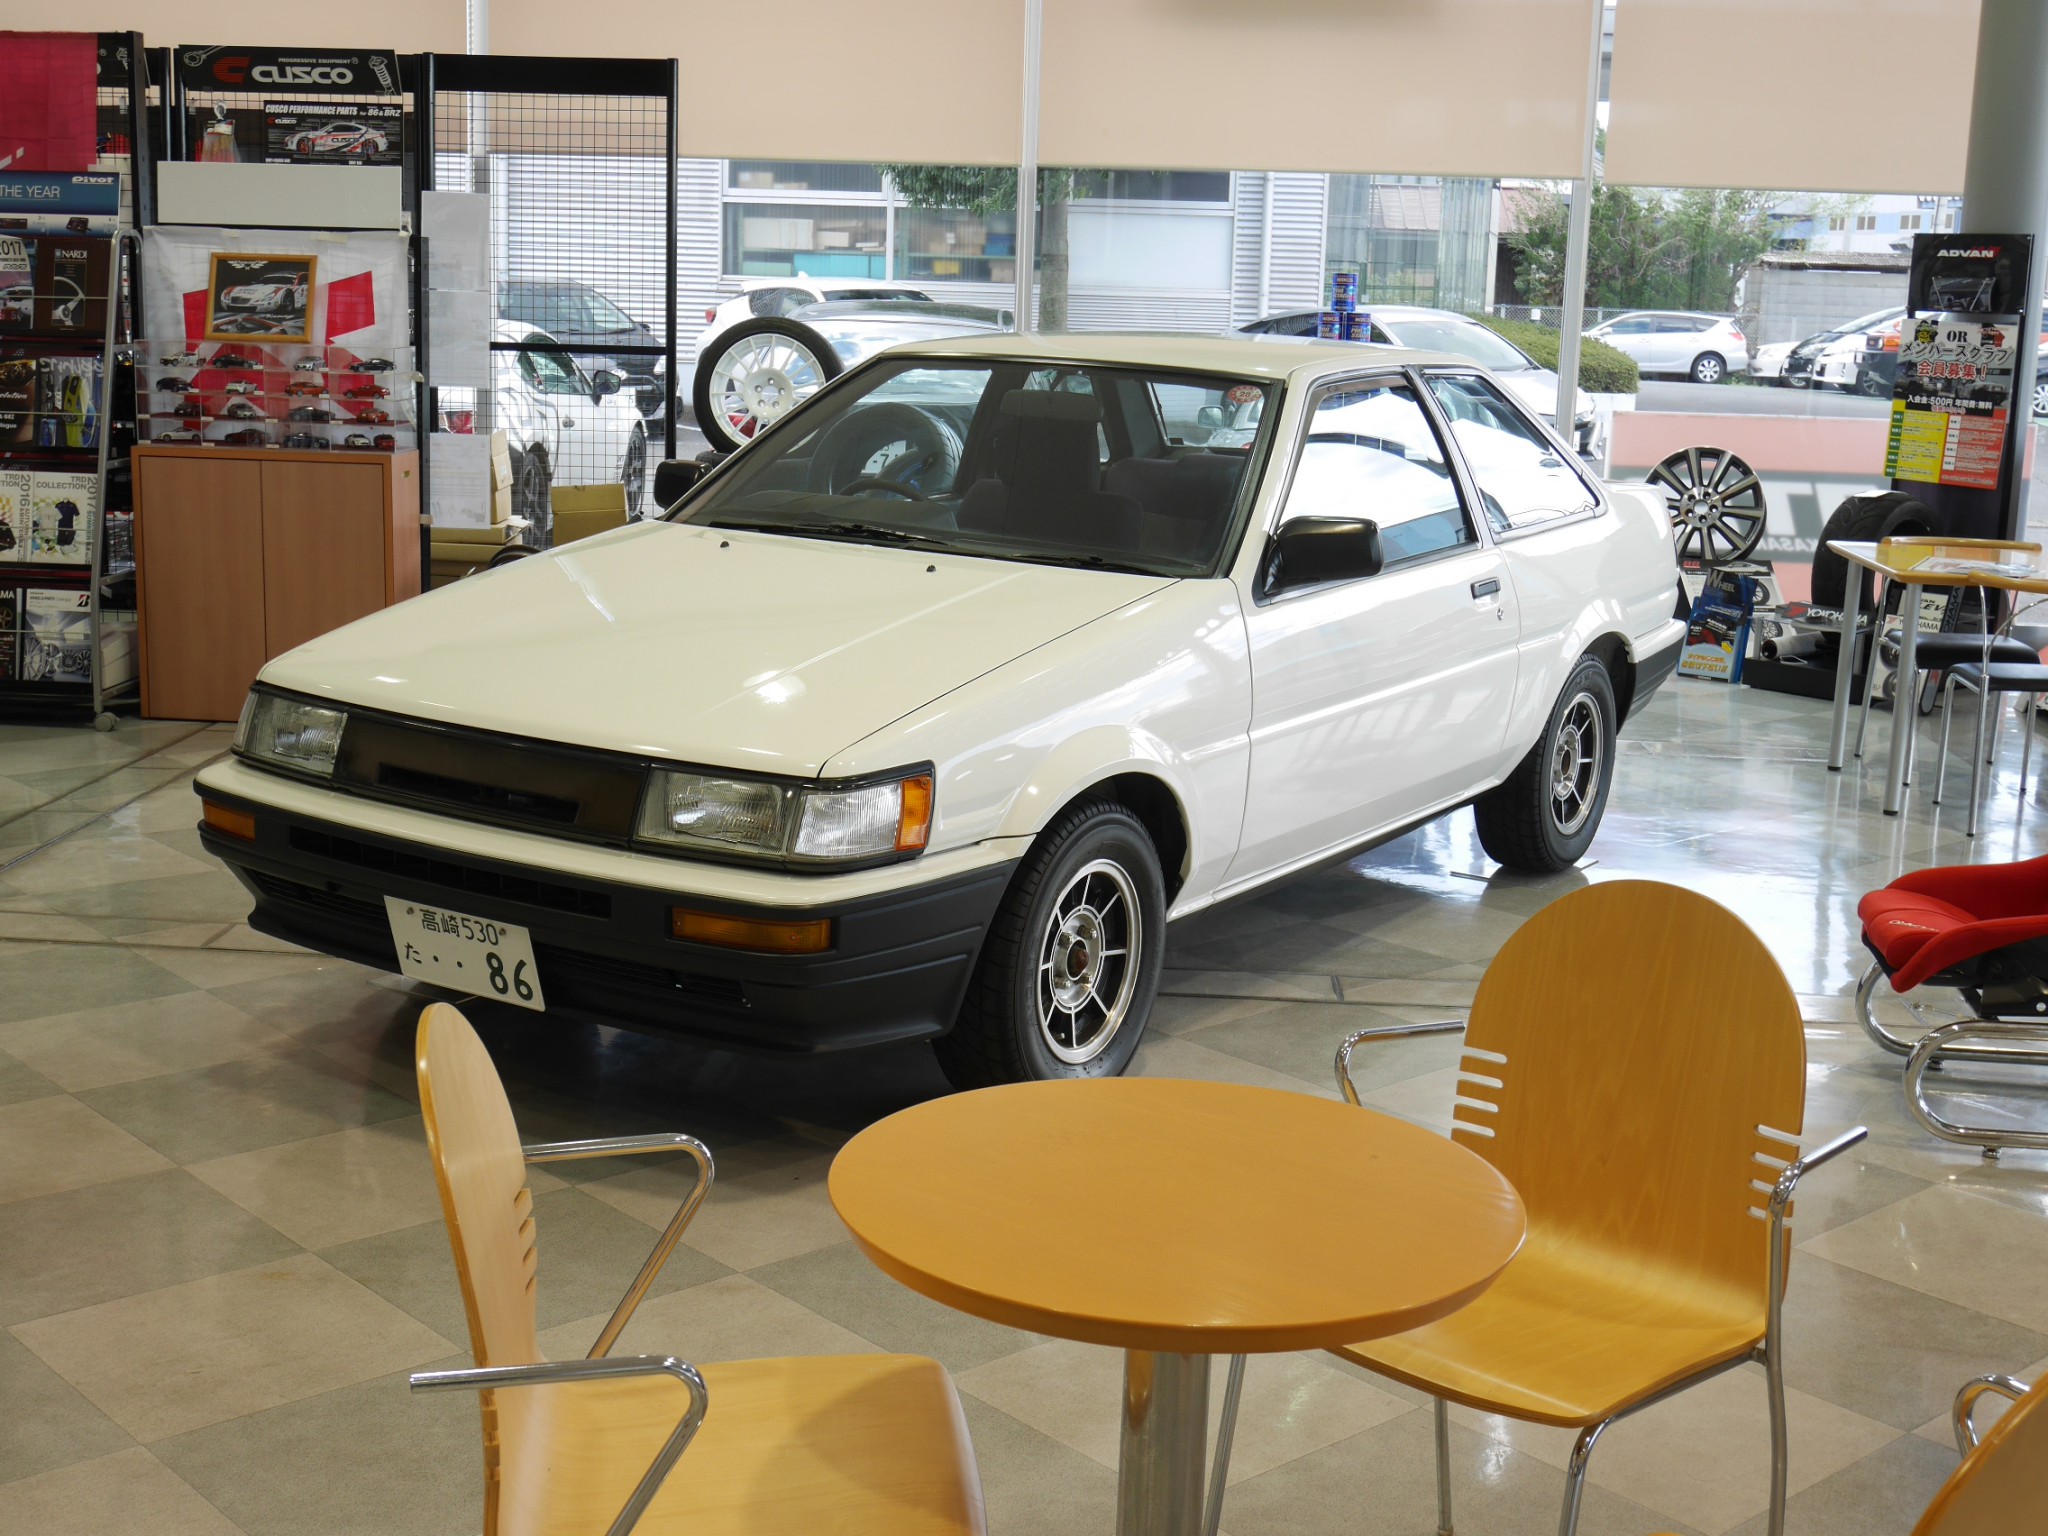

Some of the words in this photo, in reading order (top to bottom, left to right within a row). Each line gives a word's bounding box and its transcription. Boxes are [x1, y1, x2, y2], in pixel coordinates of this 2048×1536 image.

[251, 65, 354, 85] CUSCO
[265, 104, 288, 114] CUSCO
[289, 105, 335, 115] PERFORMANCE
[336, 106, 358, 116] PARTS
[367, 108, 379, 117] 86
[384, 109, 401, 117] BRZ
[26, 186, 61, 198] YEAR
[0, 240, 22, 256] 017
[61, 249, 88, 259] NARDI
[1936, 248, 1995, 258] ADVAN
[1946, 329, 1968, 343] OR
[4, 473, 20, 481] TRD
[70, 475, 87, 483] TRD
[20, 474, 31, 507] 2016
[36, 481, 87, 490] COLLECTION
[86, 476, 98, 509] 2017
[1806, 607, 1868, 627] YOKOHA
[419, 908, 499, 947] 高崎530
[404, 942, 423, 965] た
[485, 951, 534, 1002] 86
